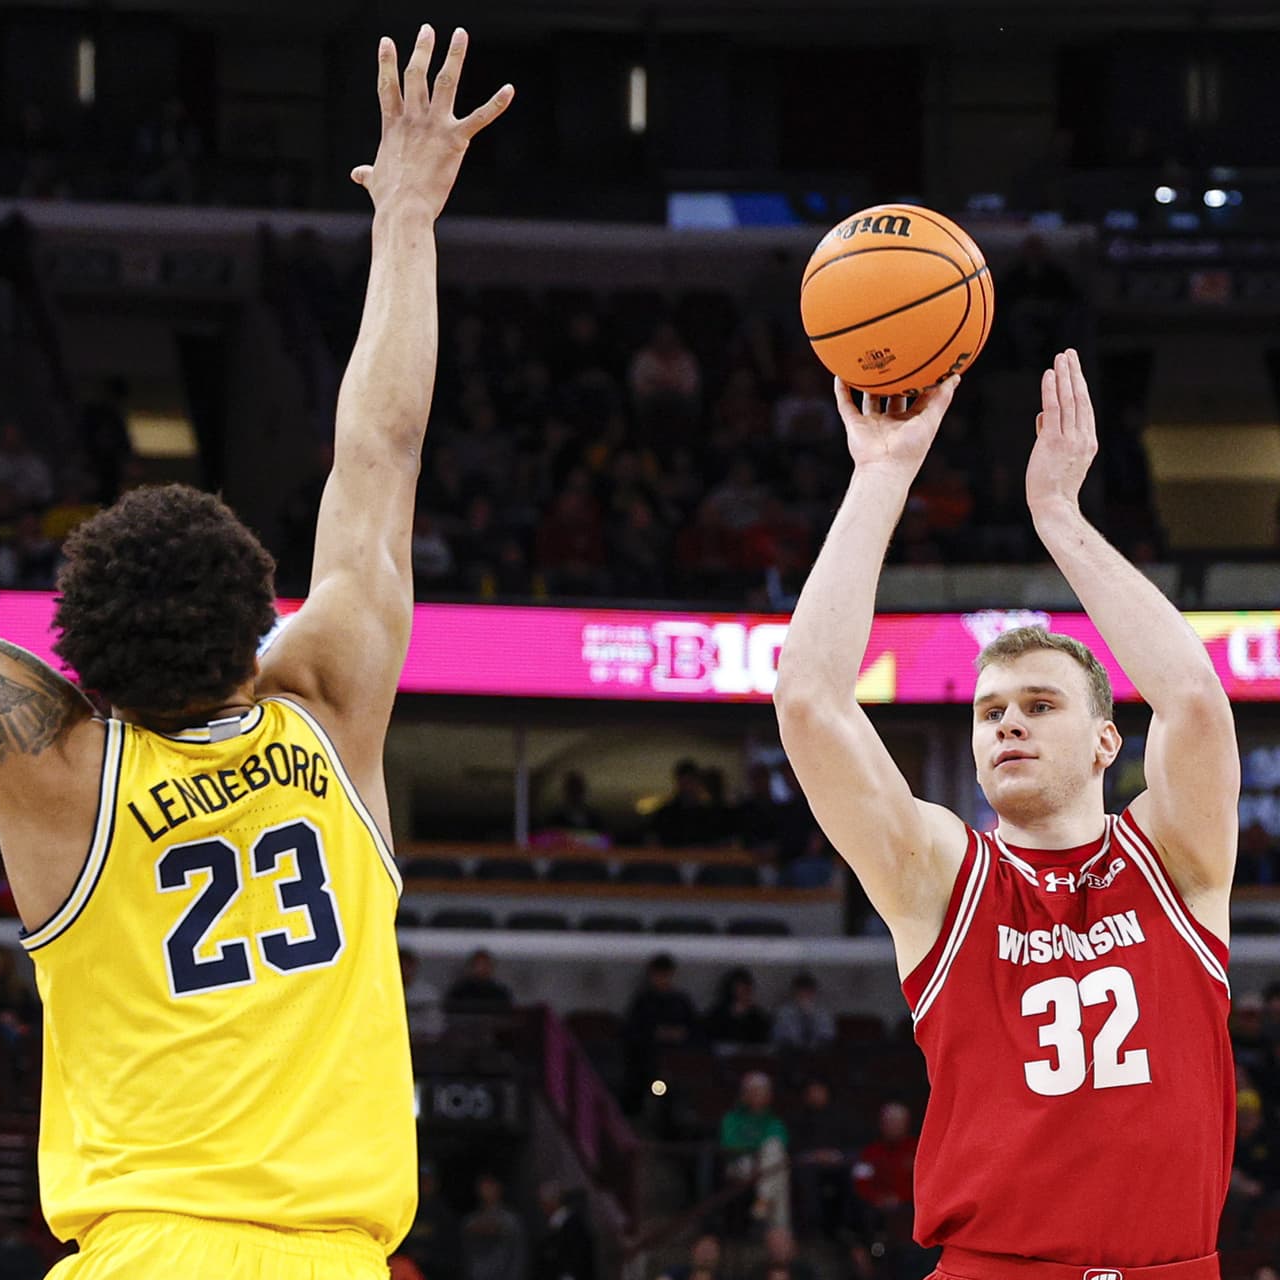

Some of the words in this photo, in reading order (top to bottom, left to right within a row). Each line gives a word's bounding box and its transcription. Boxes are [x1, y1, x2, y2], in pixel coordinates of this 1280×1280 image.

[128, 742, 329, 842] LENDEBORG
[154, 817, 345, 998] 23
[997, 910, 1146, 966] WISCONSIN
[1021, 966, 1151, 1096] 32
